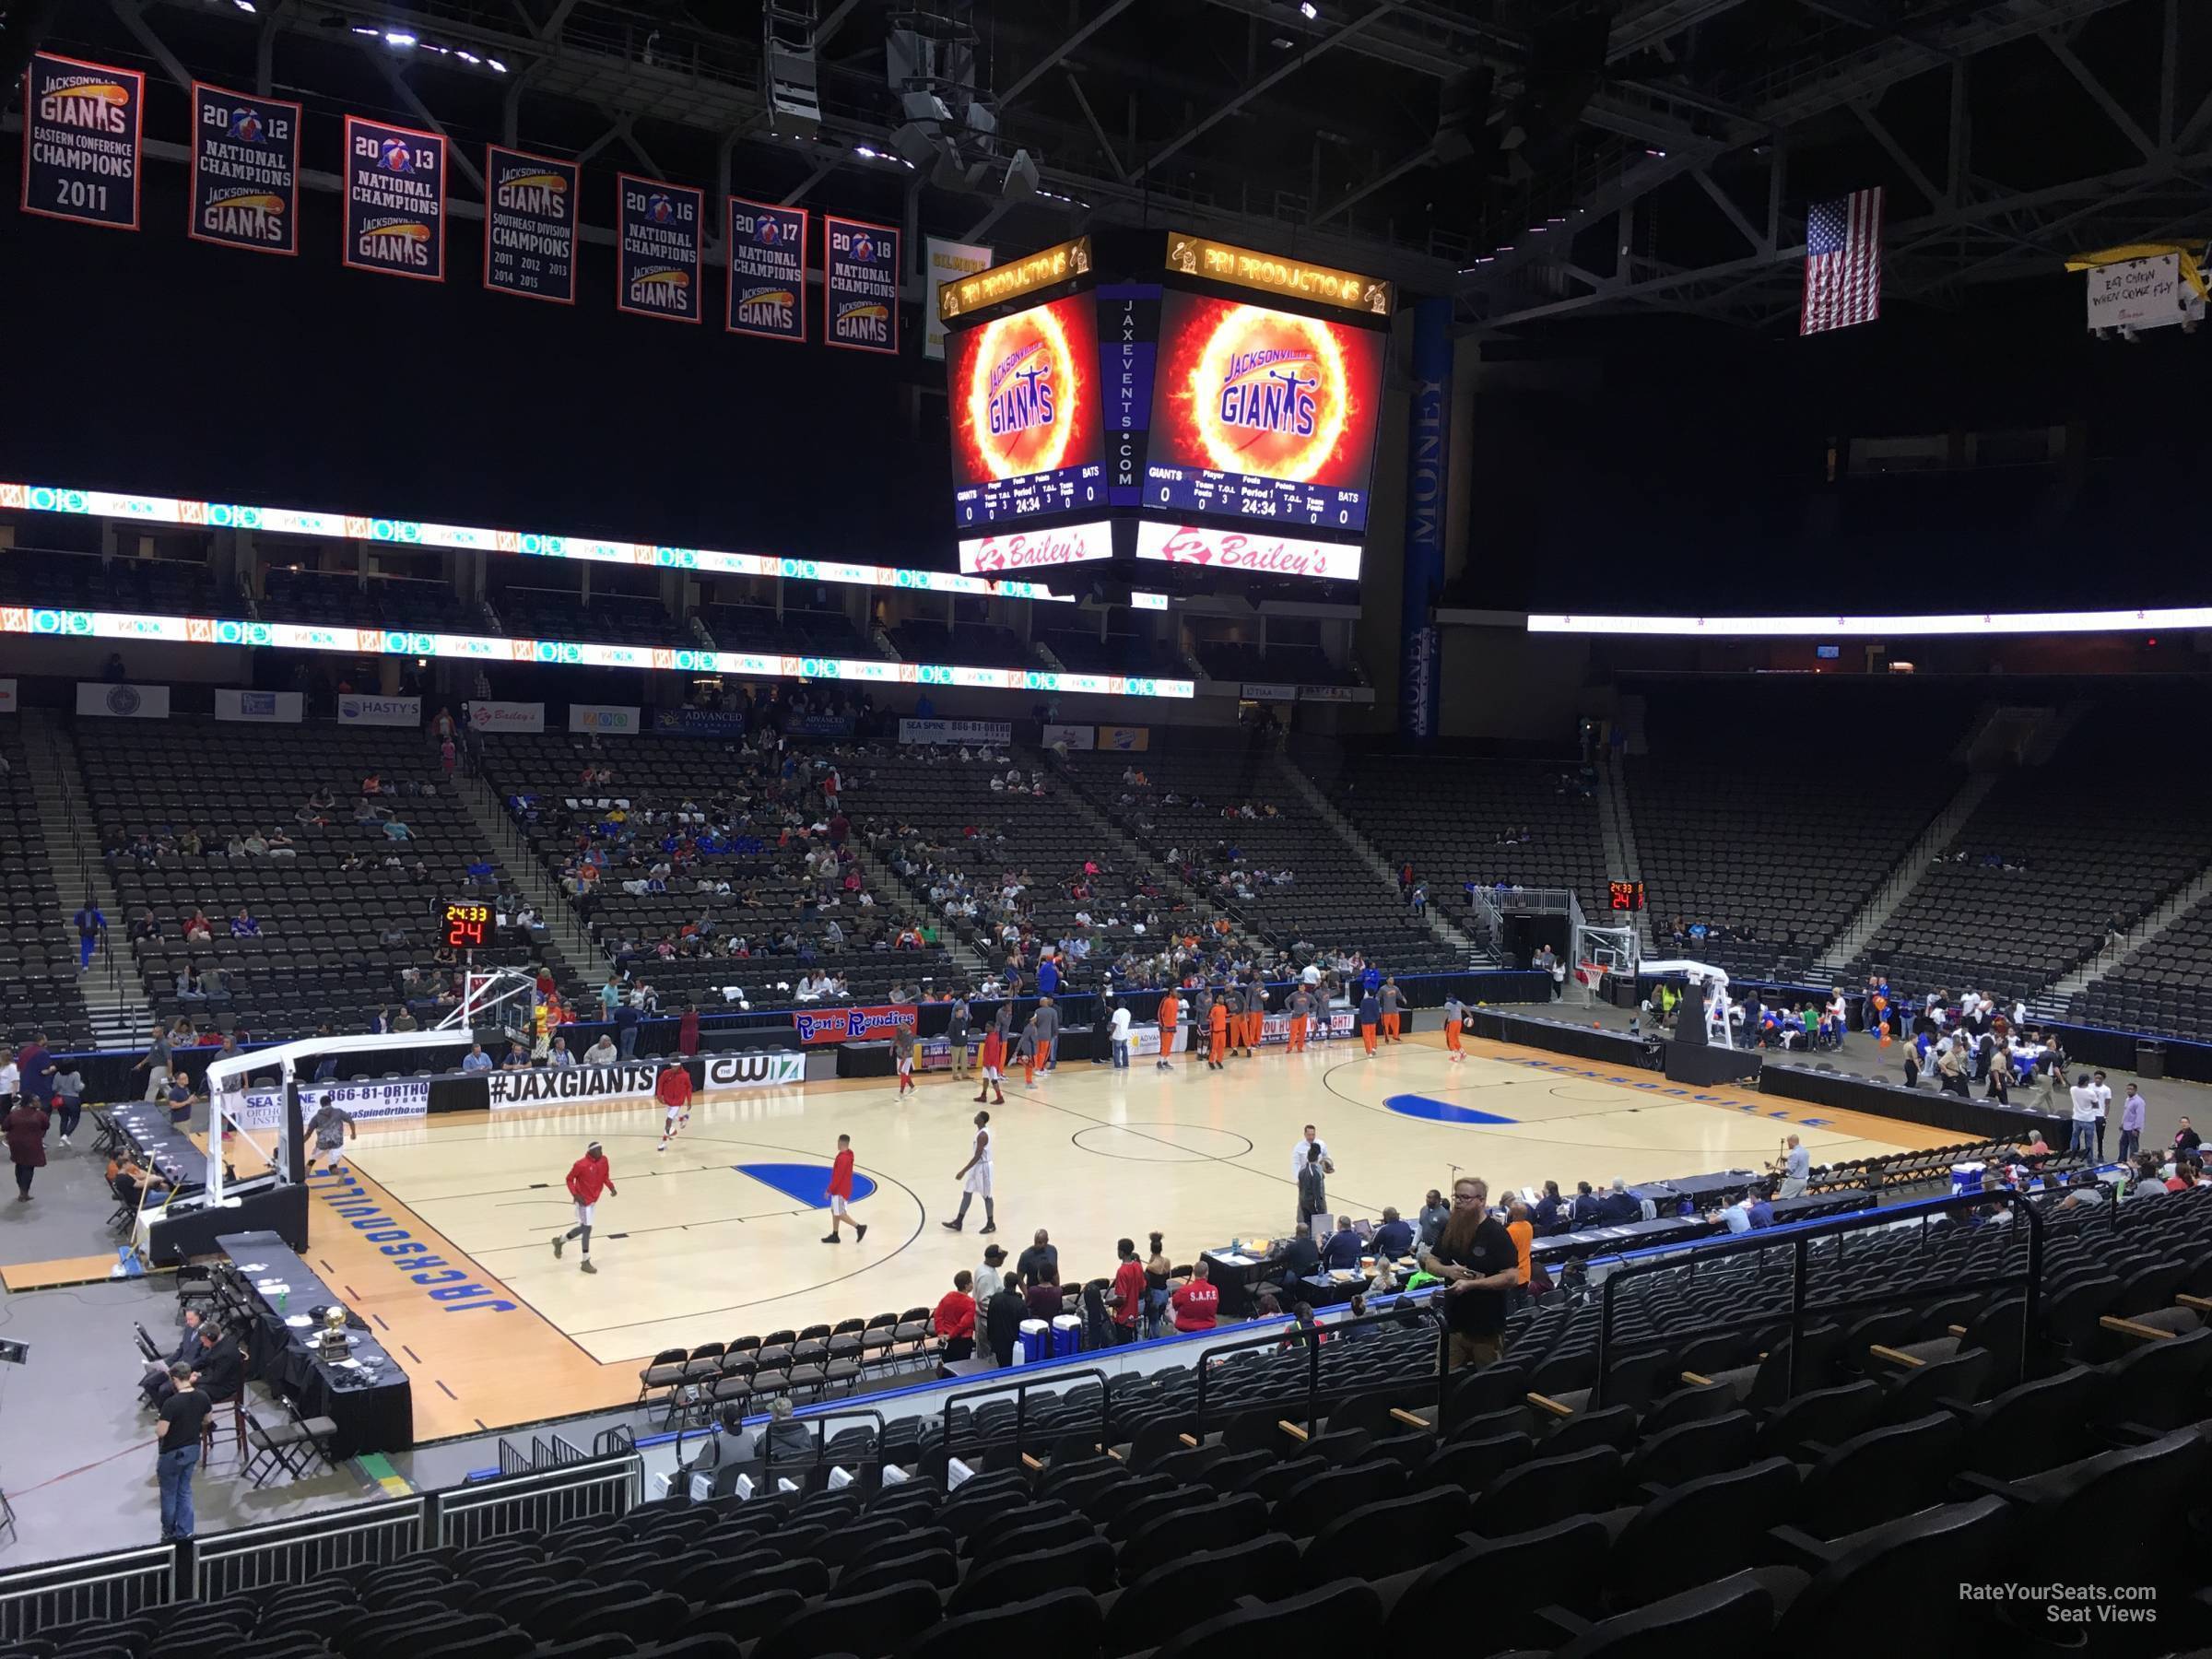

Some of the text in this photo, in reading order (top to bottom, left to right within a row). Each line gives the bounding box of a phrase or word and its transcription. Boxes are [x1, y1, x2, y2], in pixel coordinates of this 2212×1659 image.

[41, 95, 126, 134] GIANTS
[203, 104, 288, 139] 20 12
[34, 126, 132, 157] EASTERN CONFERENCE
[206, 140, 286, 169] NATIONAL
[355, 136, 434, 170] 20 13
[33, 142, 132, 178] CHAMPIONS
[200, 157, 291, 186] CHAMPIONS
[56, 178, 106, 211] 2011
[358, 171, 433, 198] NATIONAL
[352, 186, 439, 216] CHAMPIONS
[498, 185, 564, 218] GIANTS
[626, 192, 693, 221] 20 16
[204, 206, 282, 241] GIANTS
[493, 213, 570, 239] SOUTHEAST DIVISION
[629, 223, 691, 248] NATIONAL
[735, 214, 798, 241] 20 17
[359, 234, 428, 265] GIANTS
[493, 227, 570, 258] CHAMPIONS
[625, 238, 696, 264] CHAMPIONS
[738, 244, 796, 266] NATIONAL
[833, 232, 891, 258] 20 18
[495, 252, 567, 276] 2011 2012 2013
[734, 259, 802, 282] CHAMPIONS
[835, 263, 890, 283] NATIONAL
[982, 252, 1066, 298] PRODUCTIONS
[1205, 249, 1359, 301] PRI PRODUCTIONS
[495, 269, 538, 288] 2014 2015
[831, 276, 895, 298] CHAMPIONS
[2105, 276, 2122, 290] EAT
[2154, 282, 2173, 297] FLY
[630, 282, 688, 311] GIANTS
[738, 303, 793, 329] GIANTS
[836, 317, 887, 342] GIANTS
[1224, 349, 1312, 382] JACKSONVILLE
[989, 376, 1053, 434] GIANTS
[1221, 382, 1315, 435] GIANTS
[1083, 466, 1100, 478] BATS
[1148, 466, 1182, 481] GIANTS
[1415, 377, 1441, 545] MONEY
[1016, 497, 1040, 513] 24:34
[1087, 487, 1094, 501] 0
[1160, 487, 1170, 502] 0
[1199, 499, 1206, 510] 0
[1222, 494, 1228, 504] 3
[1241, 487, 1267, 499] Period
[1338, 491, 1359, 503] BATS
[966, 507, 972, 521] 0
[1241, 498, 1276, 516] 24:34
[1287, 503, 1292, 513] 3
[1311, 512, 1317, 524] 0
[1339, 510, 1348, 524] 0
[1009, 534, 1087, 567] Bailey's
[1220, 535, 1328, 575] Bailey's
[362, 701, 418, 714] HASTY'S
[685, 712, 743, 722] ADVANCED
[1610, 883, 1632, 893] 24:33
[1614, 892, 1629, 908] 24
[447, 906, 487, 921] 24:33
[450, 922, 481, 944] 24
[796, 1009, 915, 1041] Ron's Rowdies
[1333, 1016, 1350, 1028] GHT!
[711, 1057, 770, 1084] CW
[246, 1082, 429, 1108] SEA SNE 866-81-ORTHO
[490, 1066, 655, 1103] #JAXGIANTS
